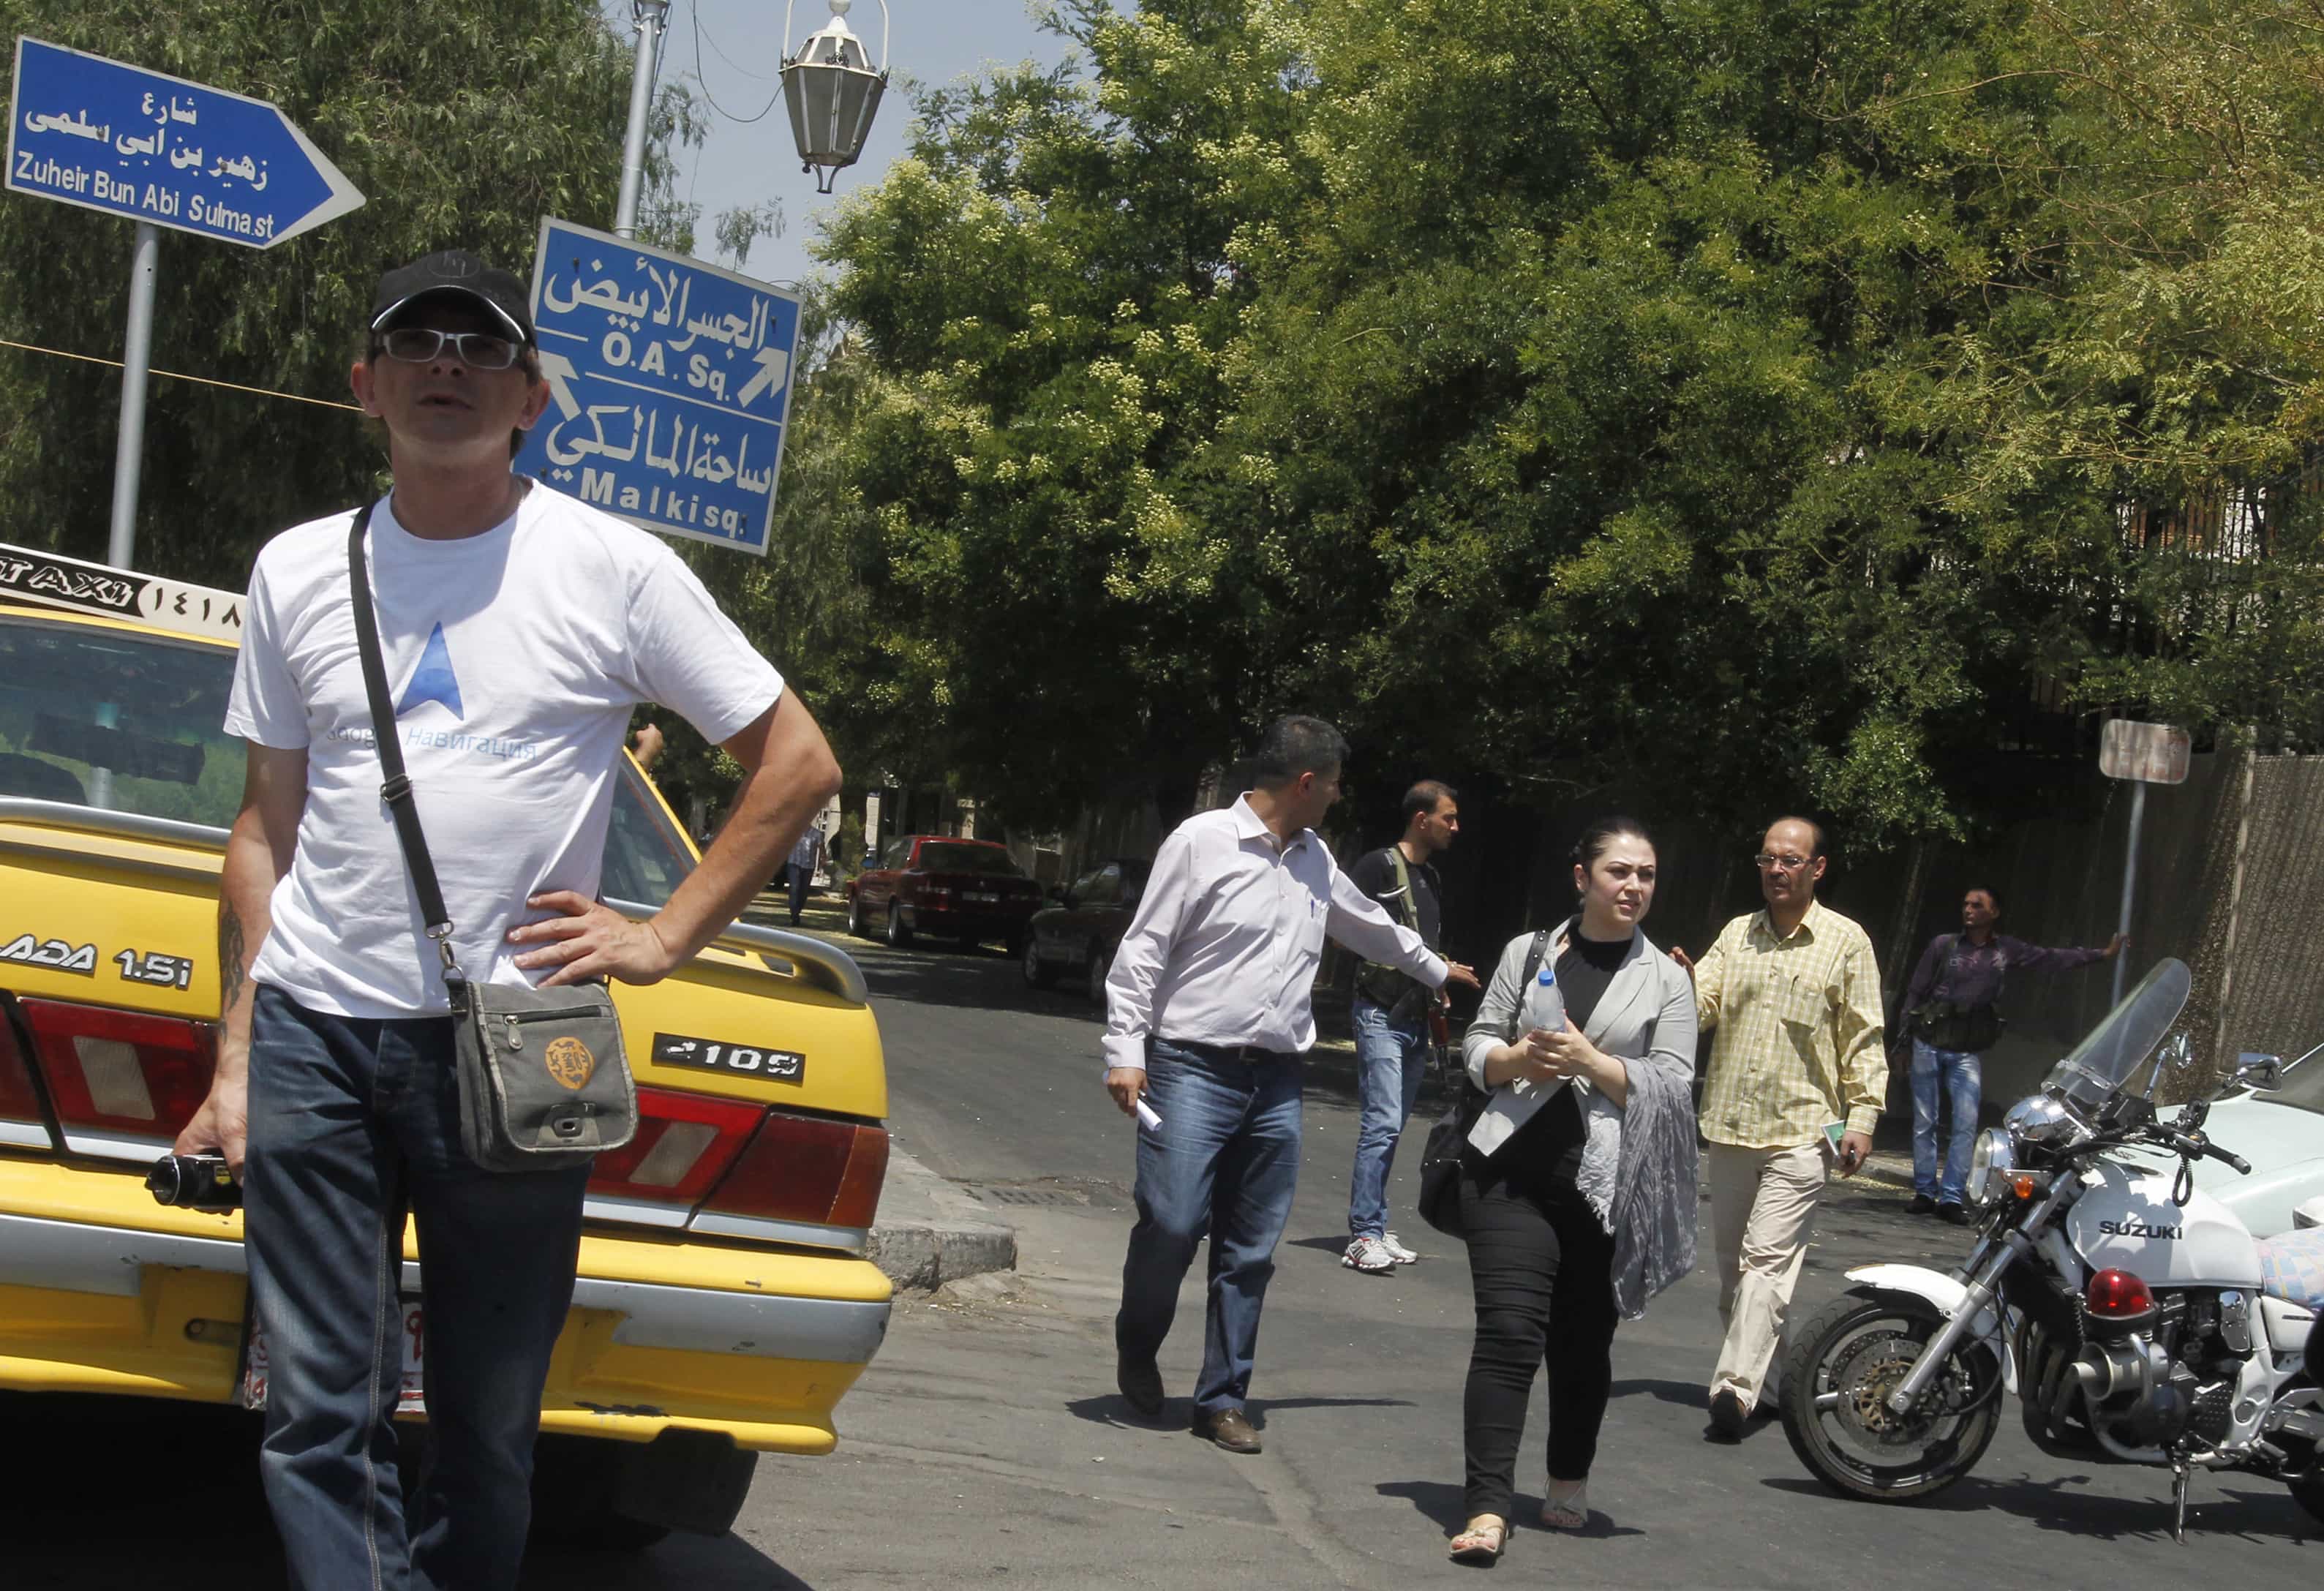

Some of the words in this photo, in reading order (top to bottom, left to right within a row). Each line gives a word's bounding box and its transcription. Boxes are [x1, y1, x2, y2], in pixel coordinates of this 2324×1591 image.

[142, 92, 196, 125] شارع
[170, 135, 203, 176] بن
[208, 155, 268, 190] زهير
[15, 150, 89, 193] Zuheir
[94, 170, 135, 206] Bun
[142, 183, 180, 217] Abi
[667, 294, 769, 360] الجسر
[545, 404, 699, 483] المالكي
[692, 432, 772, 495] ساحة
[0, 556, 134, 607] TAXI
[405, 726, 538, 761] Навигация
[0, 935, 96, 971] ADA
[116, 950, 190, 986] 1.5i
[2099, 1220, 2183, 1241] SUZUKI
